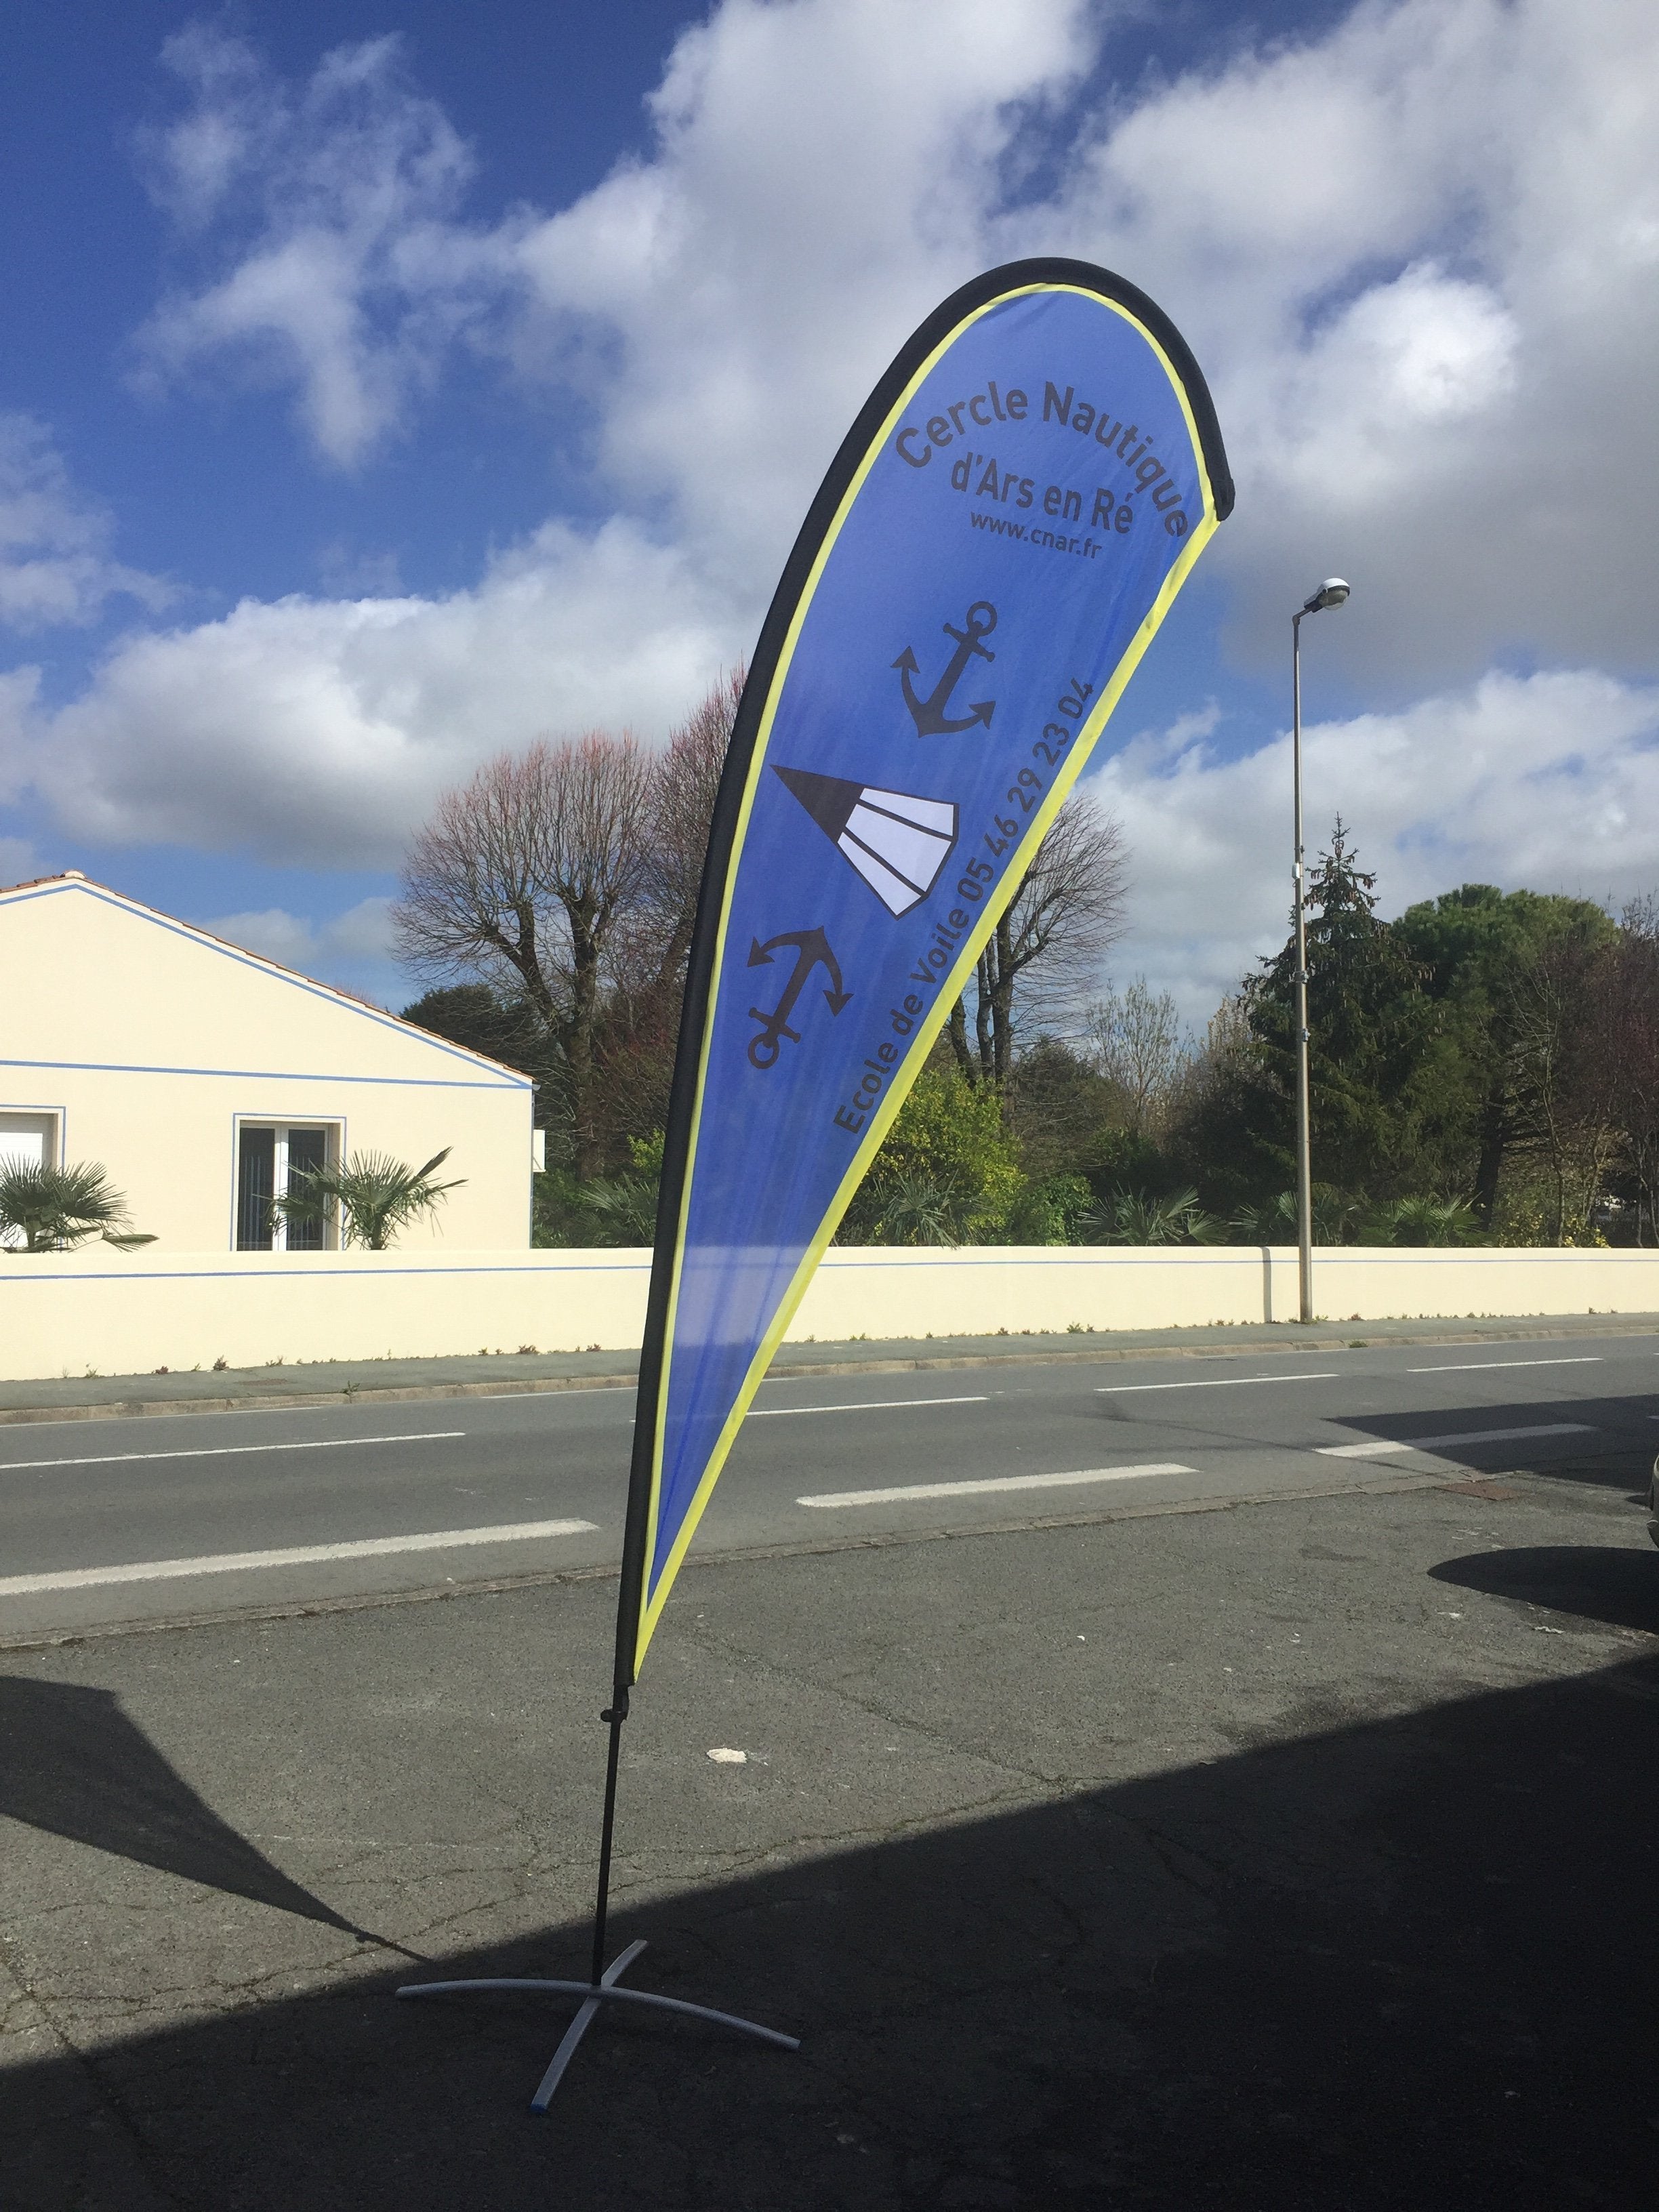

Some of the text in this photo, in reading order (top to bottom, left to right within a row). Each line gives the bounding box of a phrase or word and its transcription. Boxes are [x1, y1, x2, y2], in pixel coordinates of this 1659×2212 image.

[896, 381, 1188, 537] Cercle Nautique
[951, 452, 1133, 533] d'Ars en Ré
[970, 510, 1102, 559] www.cnar.fr
[834, 678, 1094, 1133] Ecole de Voile 05 46 29 23 04
